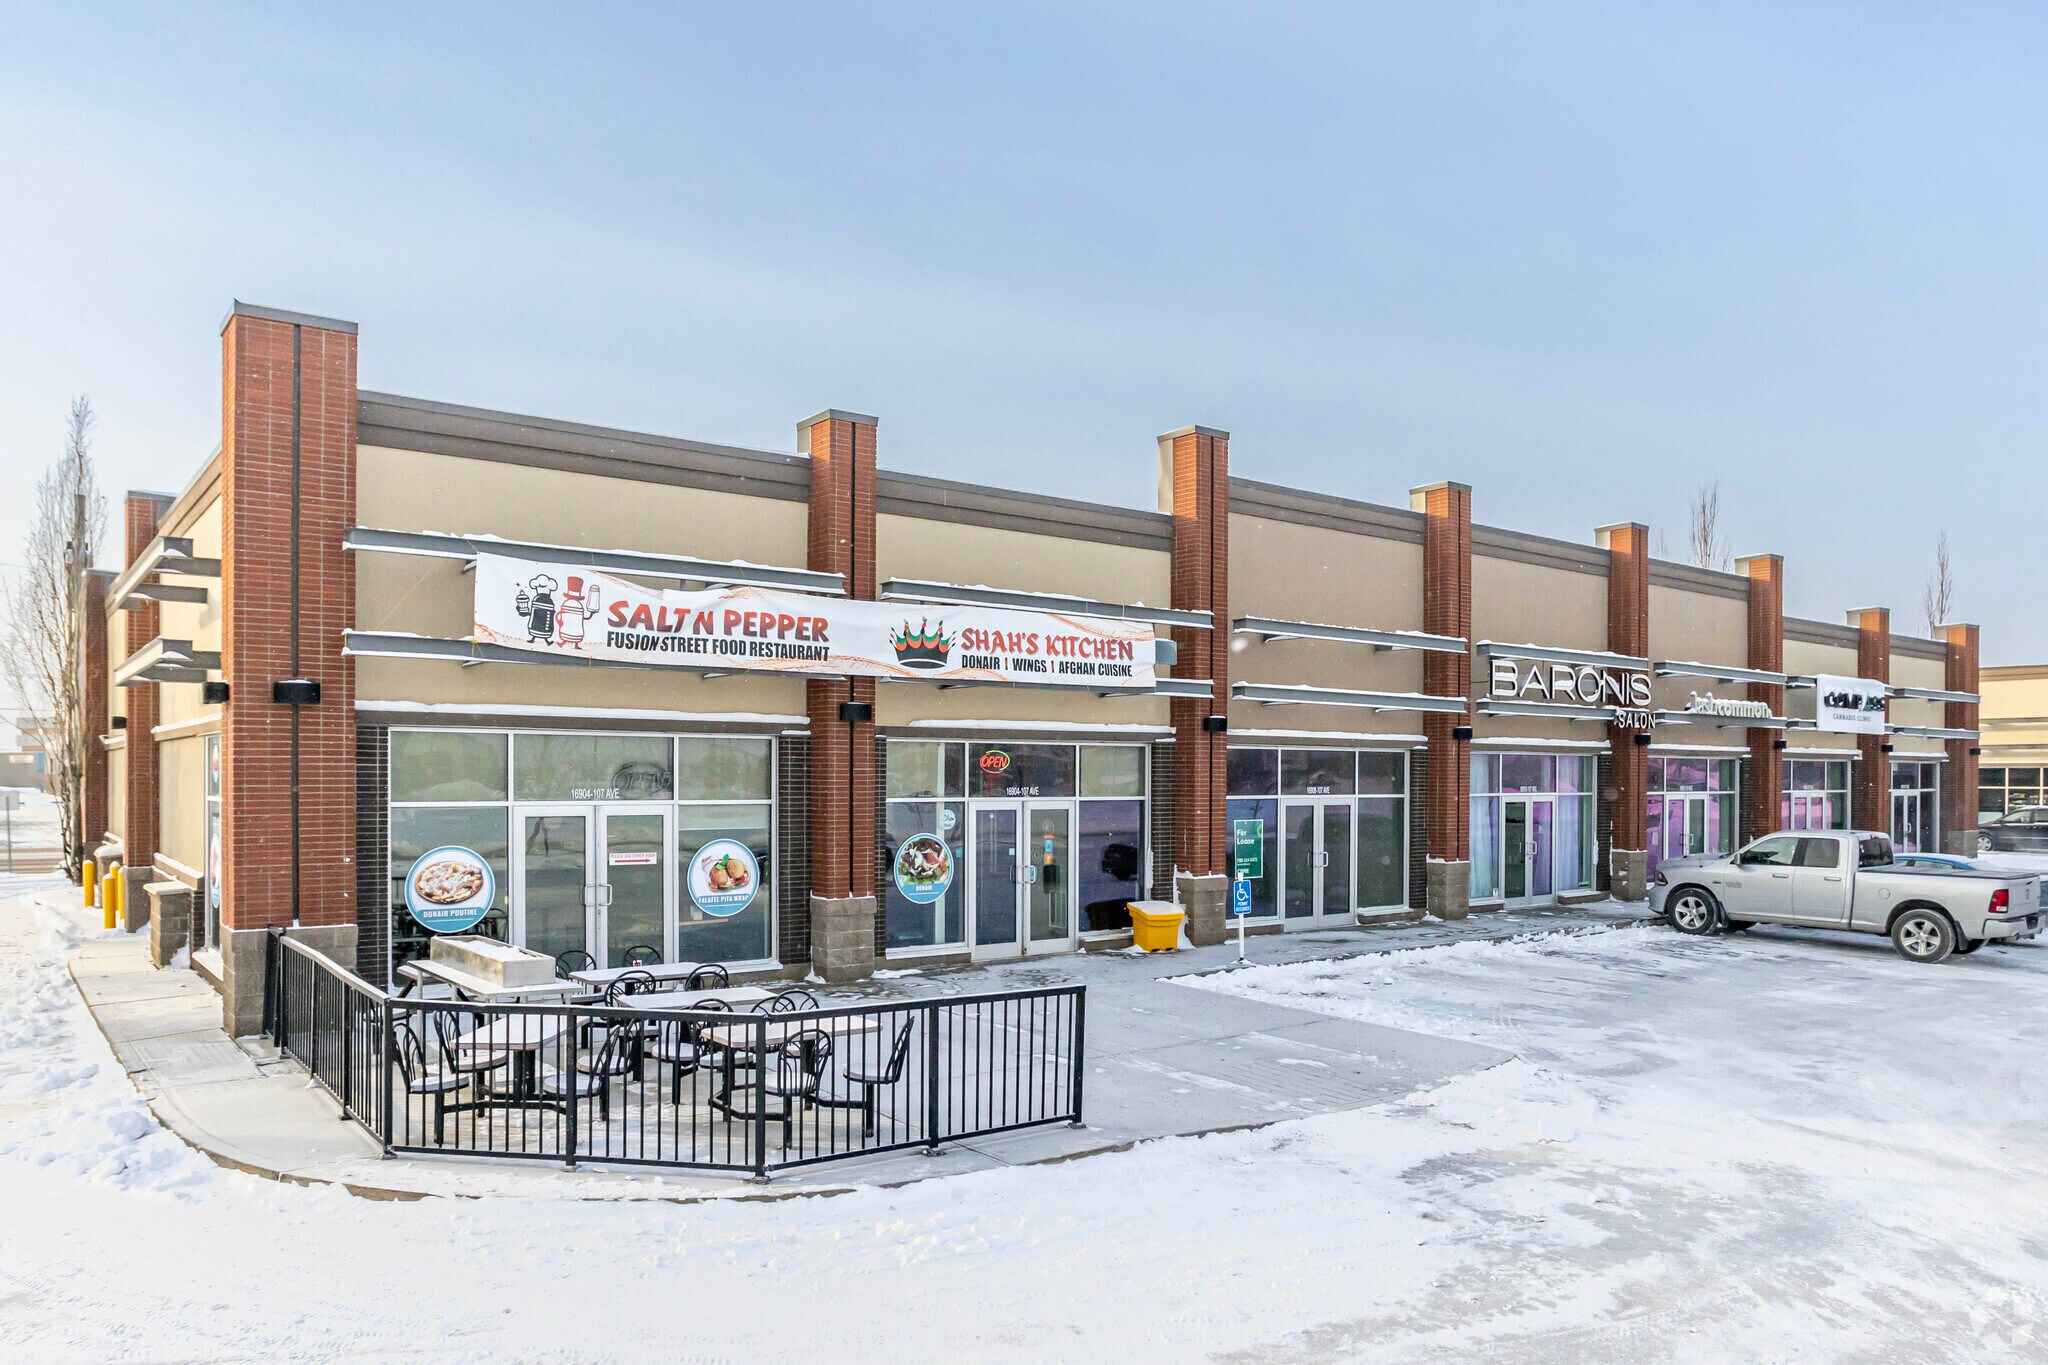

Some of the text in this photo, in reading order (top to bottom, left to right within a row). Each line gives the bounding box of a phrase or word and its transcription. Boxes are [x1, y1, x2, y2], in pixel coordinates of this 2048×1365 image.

[607, 600, 830, 643] SALT N PEPPER
[606, 630, 830, 661] FUSION STREET FOOD RESTAURANT
[960, 627, 1134, 662] SHAH'S KITCHEN
[961, 654, 1133, 677] DONAIR WINGS AFGHAN CUISINE
[1490, 659, 1652, 707] BARONIS
[1617, 711, 1656, 729] SALON
[1832, 713, 1872, 723] CANNABIS CLINIC
[982, 756, 1007, 768] OPEN
[571, 788, 620, 799] 16904-107 AVE
[1029, 786, 1040, 796] AVE
[1236, 829, 1247, 837] For
[450, 909, 478, 917] POUTINE
